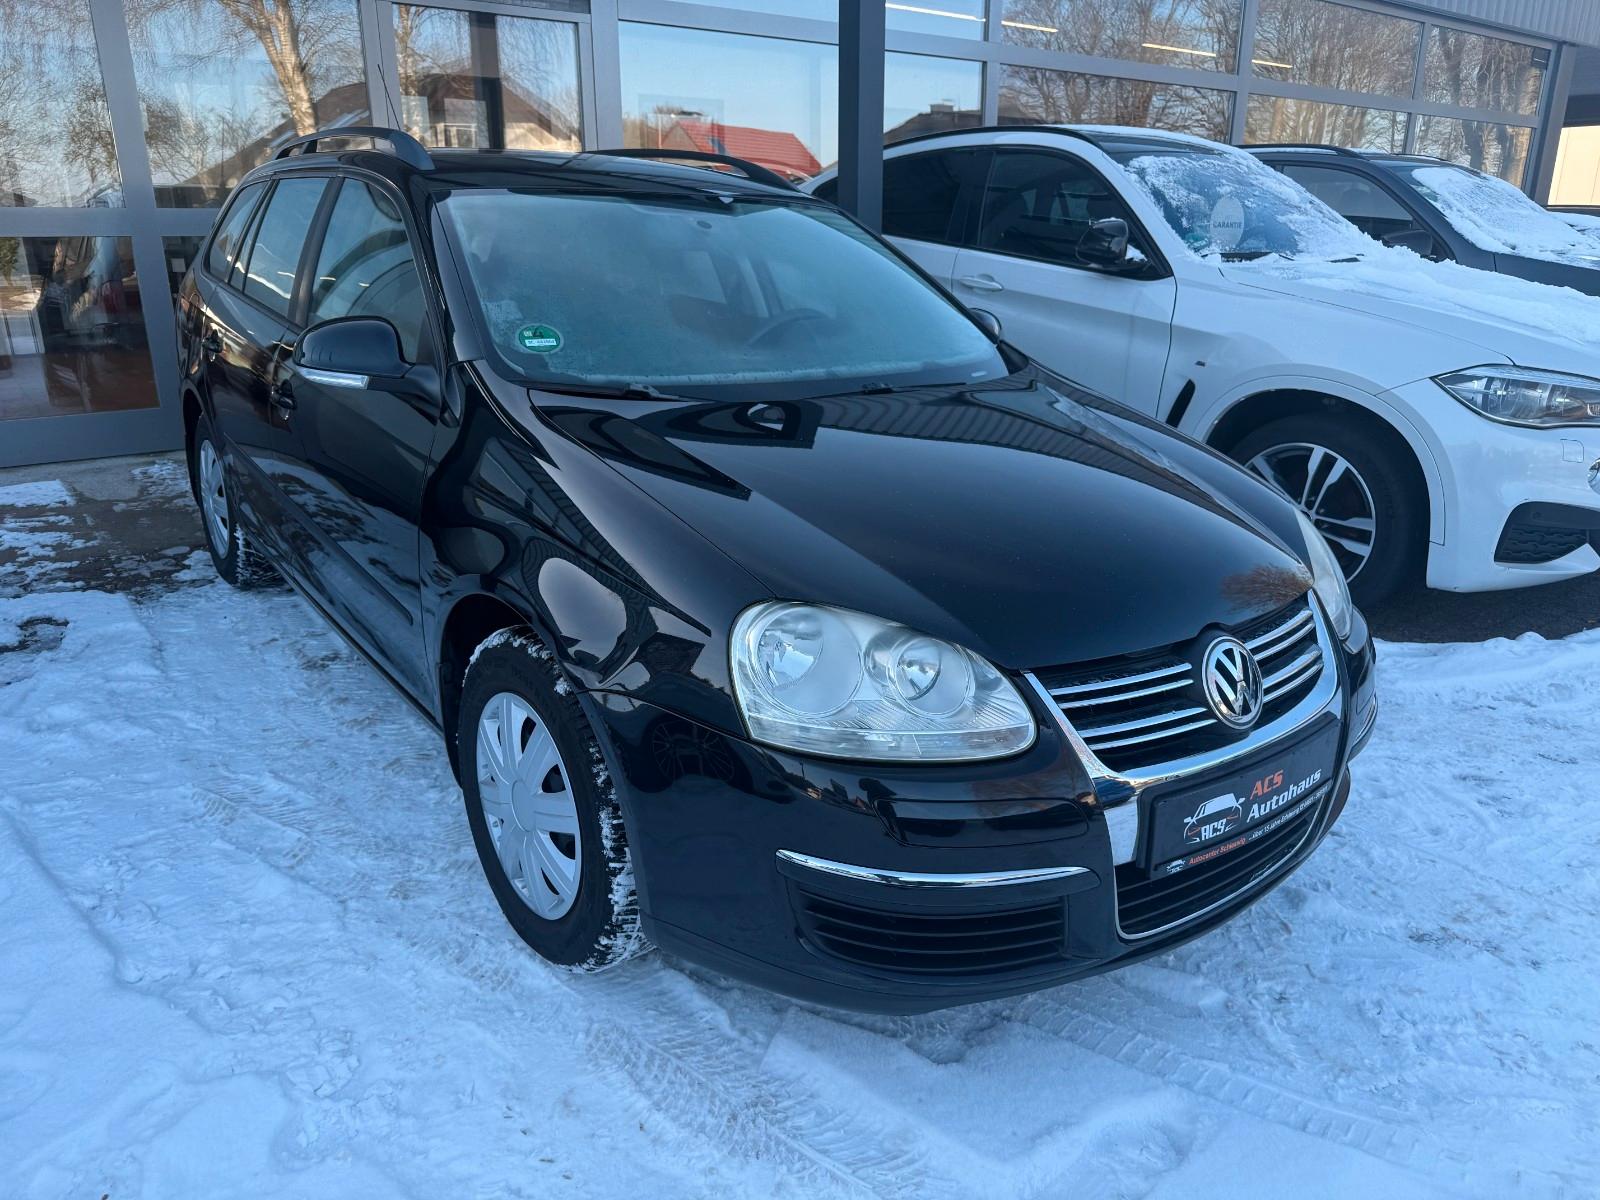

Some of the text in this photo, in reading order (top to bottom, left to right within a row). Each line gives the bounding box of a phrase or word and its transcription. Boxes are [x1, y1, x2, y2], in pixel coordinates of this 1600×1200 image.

[1247, 768, 1322, 823] Autohaus
[1250, 769, 1284, 800] ACS
[1201, 818, 1227, 841] ACS
